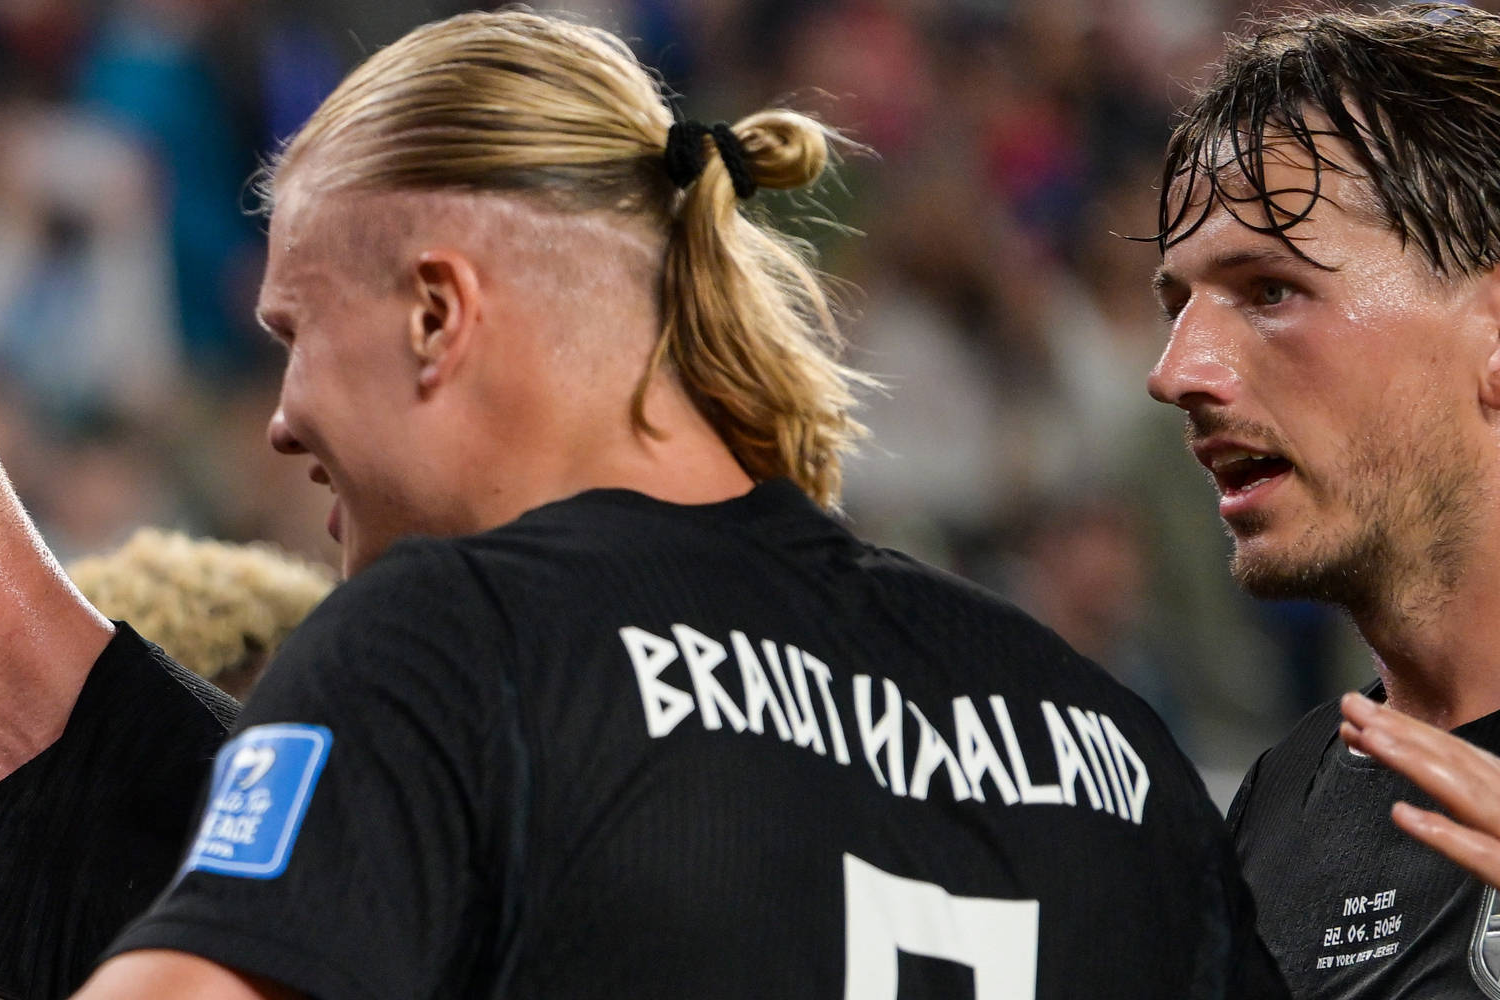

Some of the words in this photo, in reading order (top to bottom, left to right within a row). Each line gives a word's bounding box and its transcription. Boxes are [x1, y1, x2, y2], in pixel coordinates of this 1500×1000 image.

[618, 623, 850, 766] BRAUT
[852, 674, 1151, 825] HAALAND
[1343, 889, 1396, 916] NOR-SEN
[1317, 957, 1333, 969] NEW
[1336, 952, 1356, 967] YORK
[1357, 950, 1373, 962] NEW
[1373, 942, 1399, 957] JERSEY
